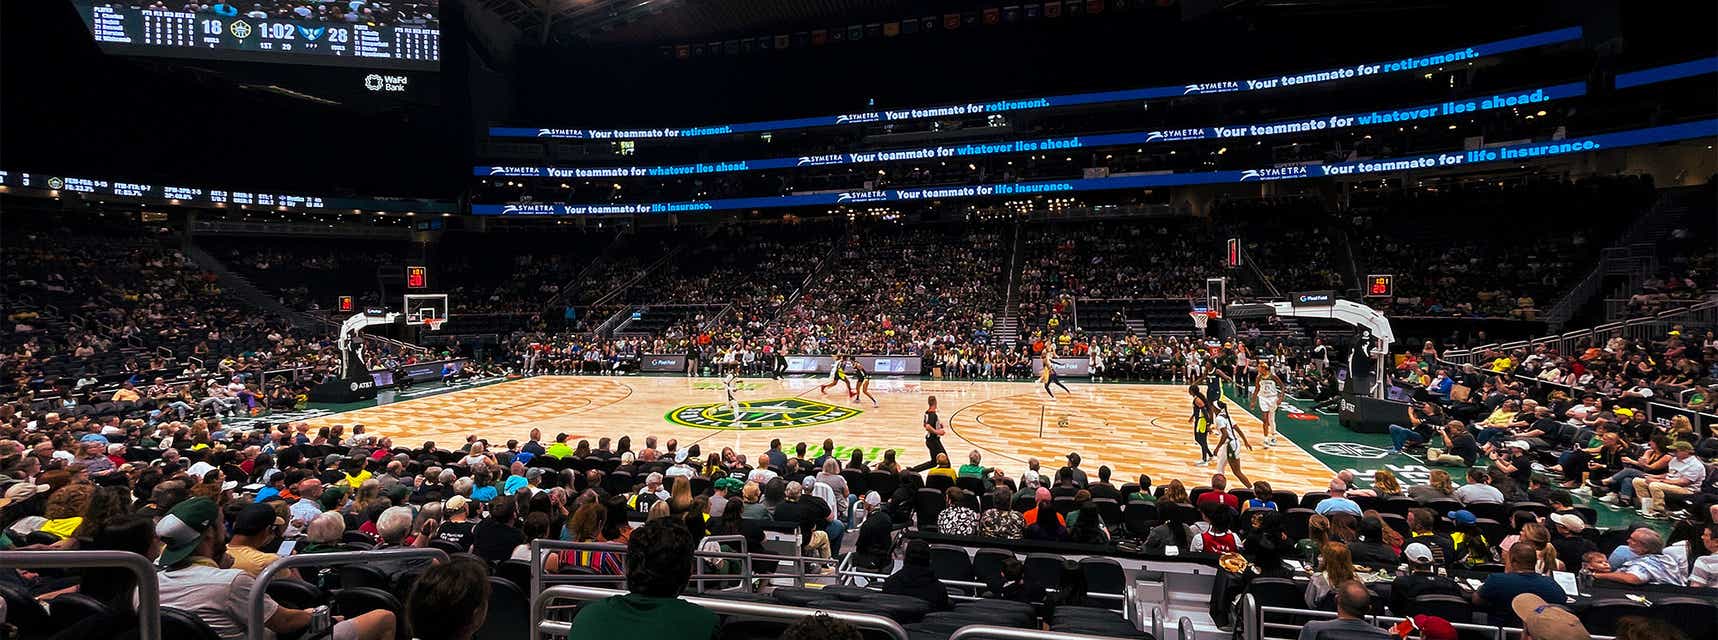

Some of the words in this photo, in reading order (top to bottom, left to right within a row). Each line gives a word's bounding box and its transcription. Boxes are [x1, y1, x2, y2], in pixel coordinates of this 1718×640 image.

[202, 20, 222, 34] 18
[259, 22, 295, 39] 1:02
[328, 28, 347, 42] 28
[1247, 80, 1278, 89] Your
[1281, 69, 1354, 86] teammate
[1357, 65, 1380, 76] for
[1384, 48, 1479, 72] retirement.
[384, 76, 407, 84] WaFd
[1200, 82, 1238, 91] SYMETRA
[885, 111, 909, 120] Your
[911, 106, 965, 118] teammate
[967, 104, 984, 114] for
[986, 98, 1049, 112] retirement.
[1214, 127, 1247, 137] Your
[1250, 120, 1326, 135] teammate
[1330, 116, 1353, 129] for
[1358, 107, 1438, 125] whatever
[1443, 102, 1476, 115] lies
[1482, 89, 1549, 110] ahead.
[589, 130, 612, 138] Your
[614, 129, 662, 138] teammate
[664, 128, 680, 137] for
[681, 126, 732, 136] retirement.
[1163, 129, 1204, 137] SYMETRA
[850, 153, 876, 163] Your
[878, 149, 934, 160] teammate
[937, 147, 954, 157] for
[957, 145, 1012, 155] whatever
[1015, 141, 1037, 151] lies
[1040, 137, 1082, 149] ahead.
[1321, 164, 1354, 175] Your
[1358, 158, 1435, 172] teammate
[1438, 153, 1464, 165] for
[1467, 150, 1496, 162] life
[1501, 140, 1600, 160] insurance.
[547, 168, 574, 177] Your
[575, 168, 628, 177] teammate
[630, 167, 646, 176] for
[649, 166, 694, 175] whatever
[697, 164, 713, 173] lies
[716, 161, 748, 171] ahead.
[1259, 166, 1307, 177] SYMETRA
[896, 191, 920, 200] Your
[922, 187, 974, 197] teammate
[976, 186, 992, 195] for
[995, 185, 1012, 194] life
[1015, 182, 1073, 194] insurance.
[564, 206, 586, 214] Your
[588, 204, 635, 213] teammate
[637, 204, 651, 212] for
[652, 203, 666, 212] life
[667, 200, 712, 211] insurance.
[640, 501, 649, 512] 13
